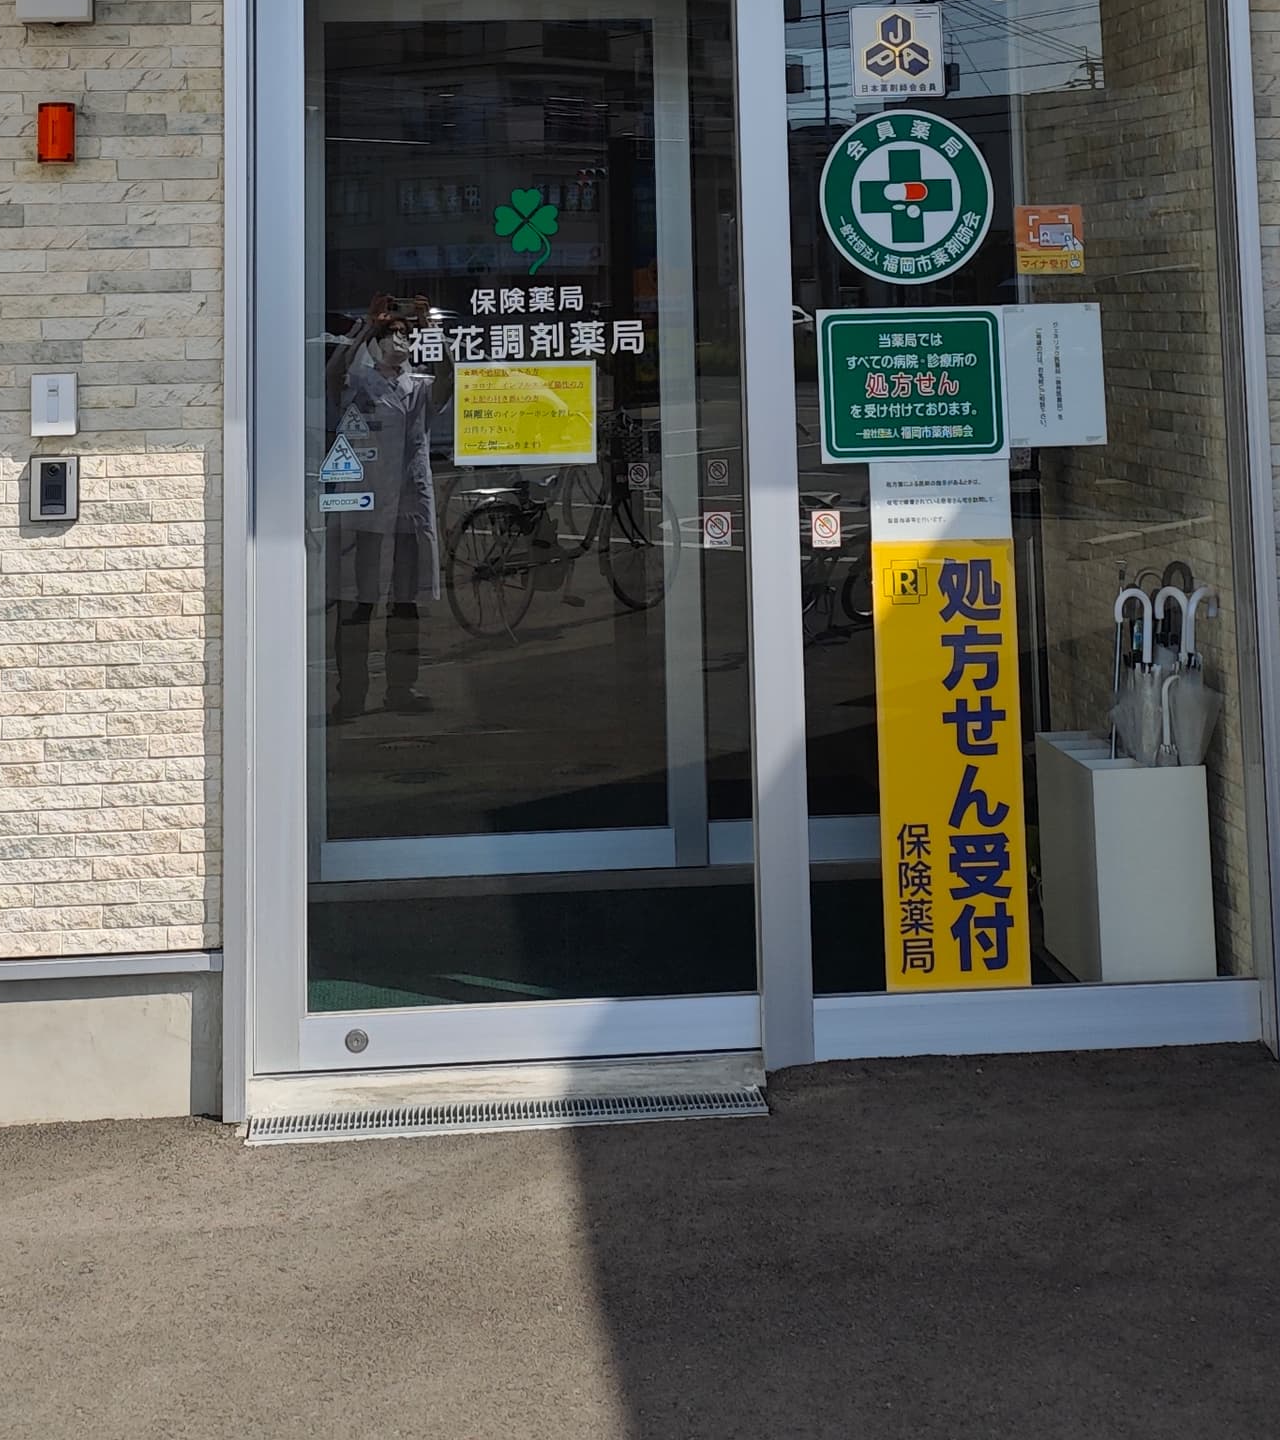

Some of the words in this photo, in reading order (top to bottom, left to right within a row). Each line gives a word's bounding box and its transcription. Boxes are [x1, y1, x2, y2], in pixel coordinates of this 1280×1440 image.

[860, 82, 937, 94] 日本薬剤師会会員
[845, 119, 963, 162] 会員薬局
[882, 211, 981, 275] 福岡市薬剤師会
[470, 285, 584, 315] 保険薬局
[408, 320, 646, 363] 福花調剤薬局
[878, 333, 943, 349] 当薬局では
[845, 353, 977, 370] すべての病院・診療所の
[865, 370, 960, 399] 処方せん
[850, 401, 977, 419] を受け付けております。
[938, 557, 1014, 972] 処方せん受付
[896, 823, 935, 975] 保険薬局
